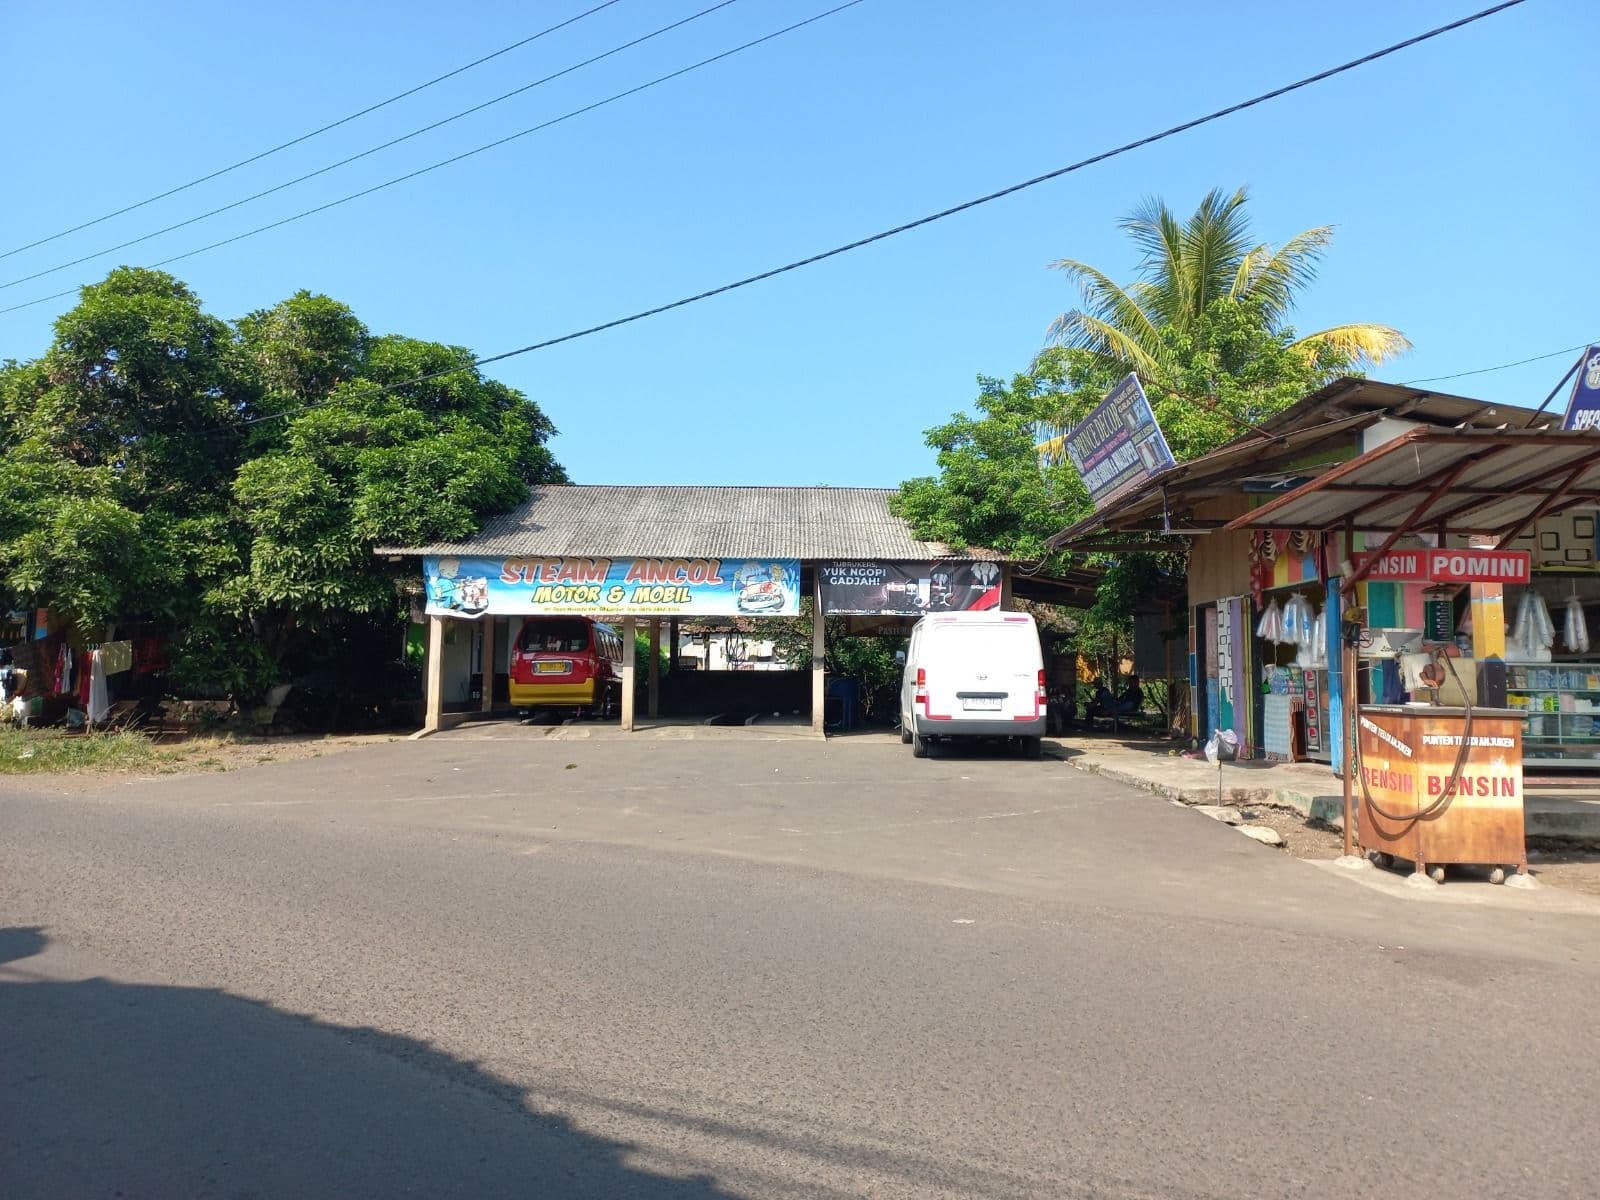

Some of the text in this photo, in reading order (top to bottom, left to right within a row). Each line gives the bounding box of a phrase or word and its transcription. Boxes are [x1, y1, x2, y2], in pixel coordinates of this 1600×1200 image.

[1073, 422, 1101, 458] PRINCE
[1095, 402, 1124, 441] DECOR
[500, 558, 724, 584] STEAM ANCOL
[823, 568, 886, 577] YUK NGOPI
[1433, 556, 1524, 577] POMINI
[830, 577, 880, 586] GADJAH!
[531, 585, 692, 604] MOTOR & MOBIL
[1363, 766, 1413, 795] BENSIN
[1427, 775, 1516, 798] BENSIN
